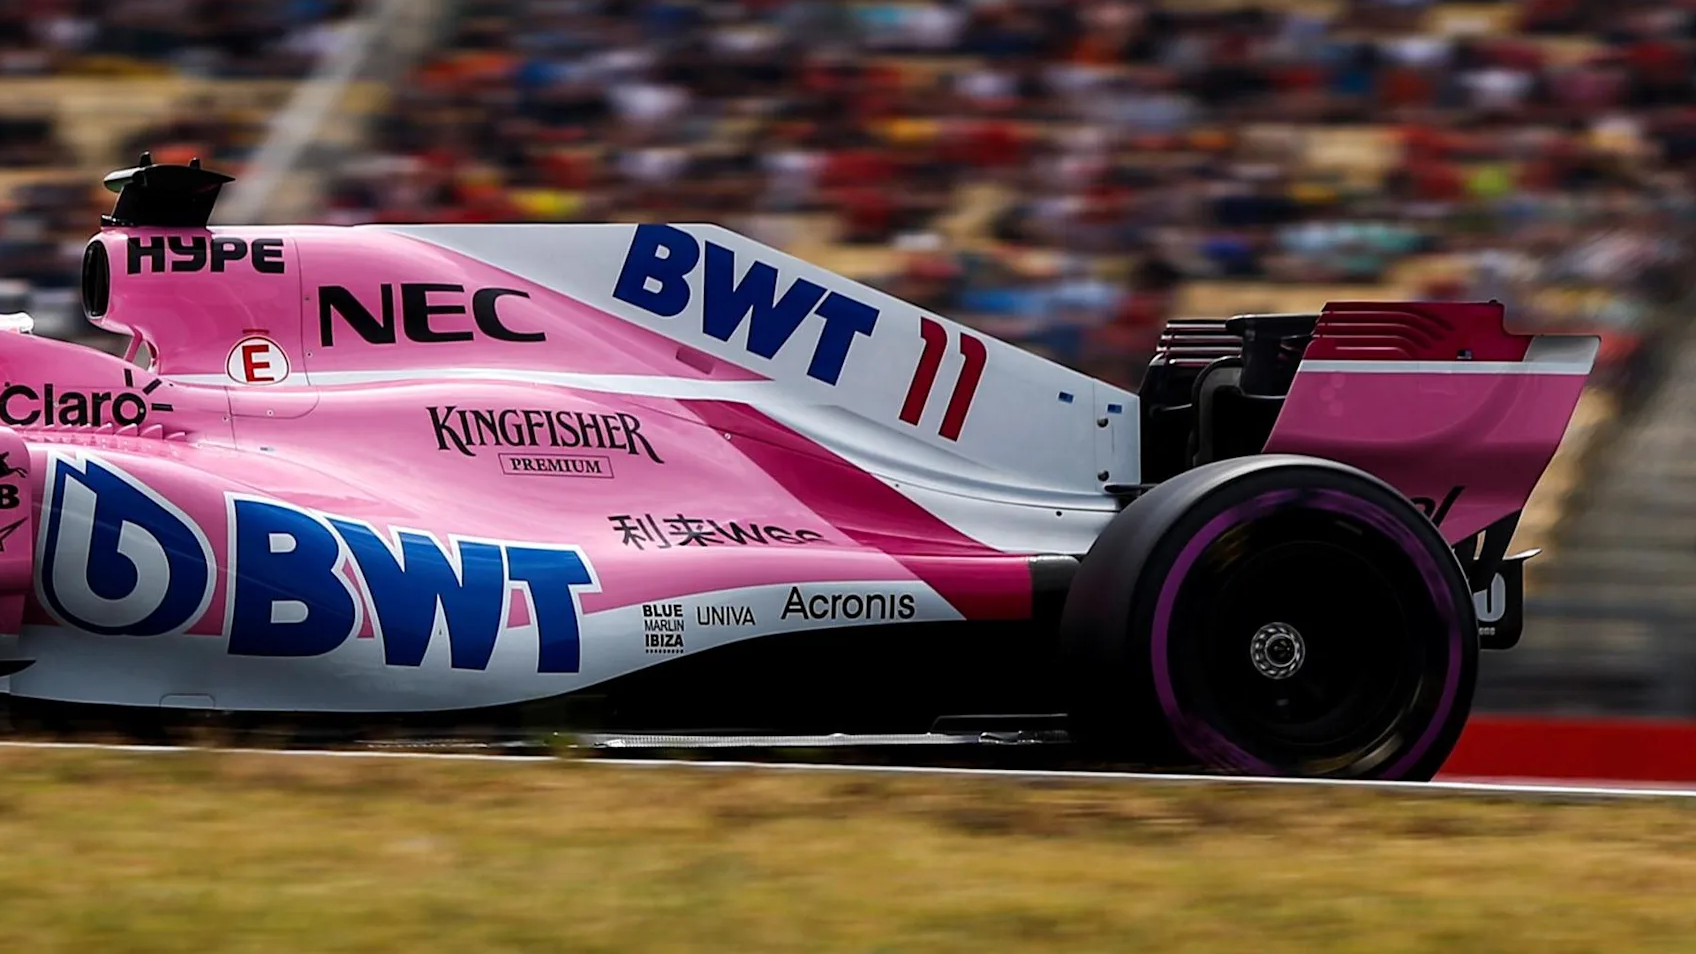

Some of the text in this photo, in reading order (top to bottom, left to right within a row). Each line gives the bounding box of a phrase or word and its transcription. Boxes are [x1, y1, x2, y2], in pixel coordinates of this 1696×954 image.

[126, 235, 285, 275] HYPE
[318, 283, 546, 347] NEC
[612, 223, 880, 387] BWT
[241, 344, 273, 383] E
[899, 316, 988, 442] 11
[425, 406, 665, 464] KINGFISHER
[509, 457, 602, 474] PREMIUM
[227, 499, 594, 673] BWT
[780, 586, 916, 620] Acronis
[642, 604, 683, 618] BLUE
[644, 620, 685, 632] MARLIN
[696, 606, 756, 626] UNIVA
[644, 634, 684, 647] IBIZA
